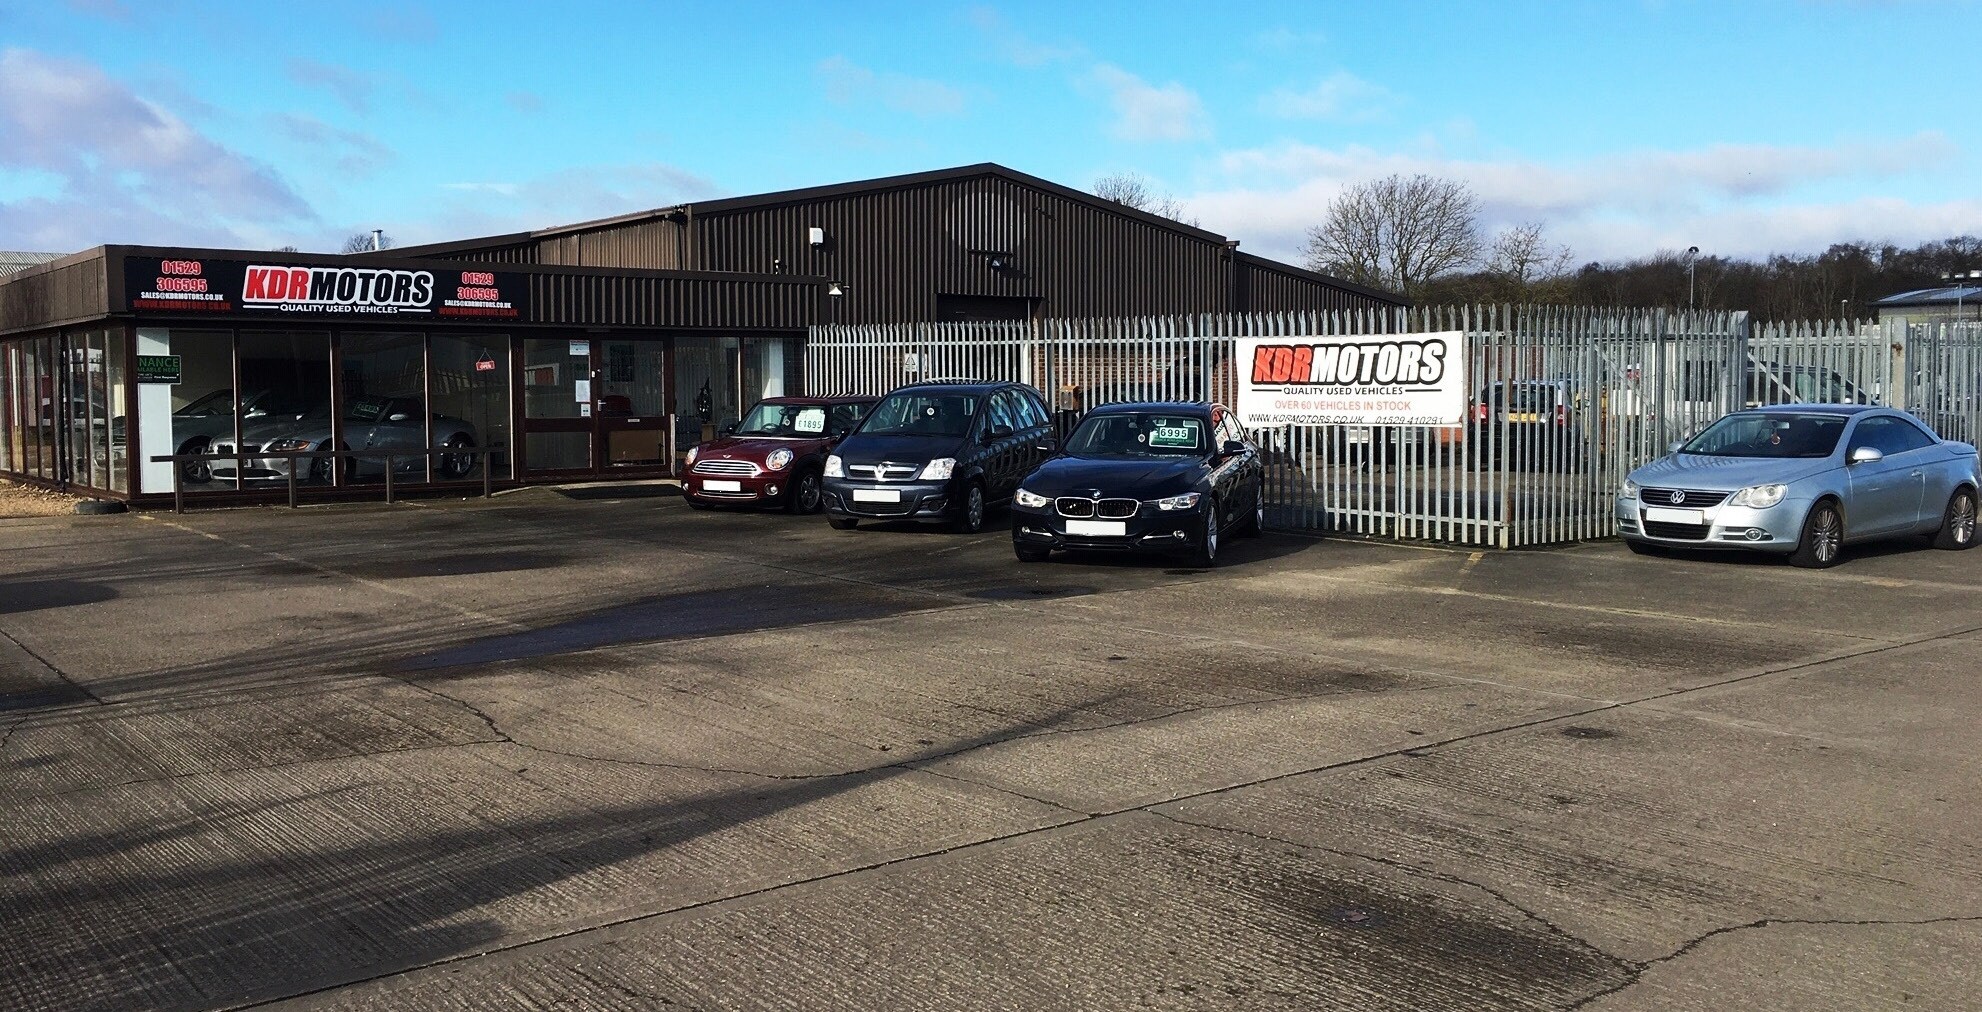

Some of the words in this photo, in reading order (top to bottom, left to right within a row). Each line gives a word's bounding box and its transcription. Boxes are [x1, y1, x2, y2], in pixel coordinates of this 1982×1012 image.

[162, 260, 201, 275] 01529
[462, 271, 494, 285] 01529
[156, 277, 208, 292] 306595
[141, 291, 224, 301] SALES@KDRMOTORS.CO.UK
[457, 287, 499, 301] 306595
[280, 303, 322, 312] QUALITY
[326, 304, 351, 313] USED
[353, 305, 398, 314] VEHICLES
[1283, 387, 1324, 395] QUALITY
[1326, 387, 1352, 395] USED
[1354, 387, 1403, 395] VEHICLES
[1275, 400, 1300, 410] OVER
[1301, 401, 1312, 410] 60
[1313, 401, 1361, 410] VEHICLES
[1363, 401, 1374, 410] IN
[1376, 401, 1411, 411] STOCK
[1375, 415, 1406, 425] 01529
[1160, 428, 1187, 438] 6995
